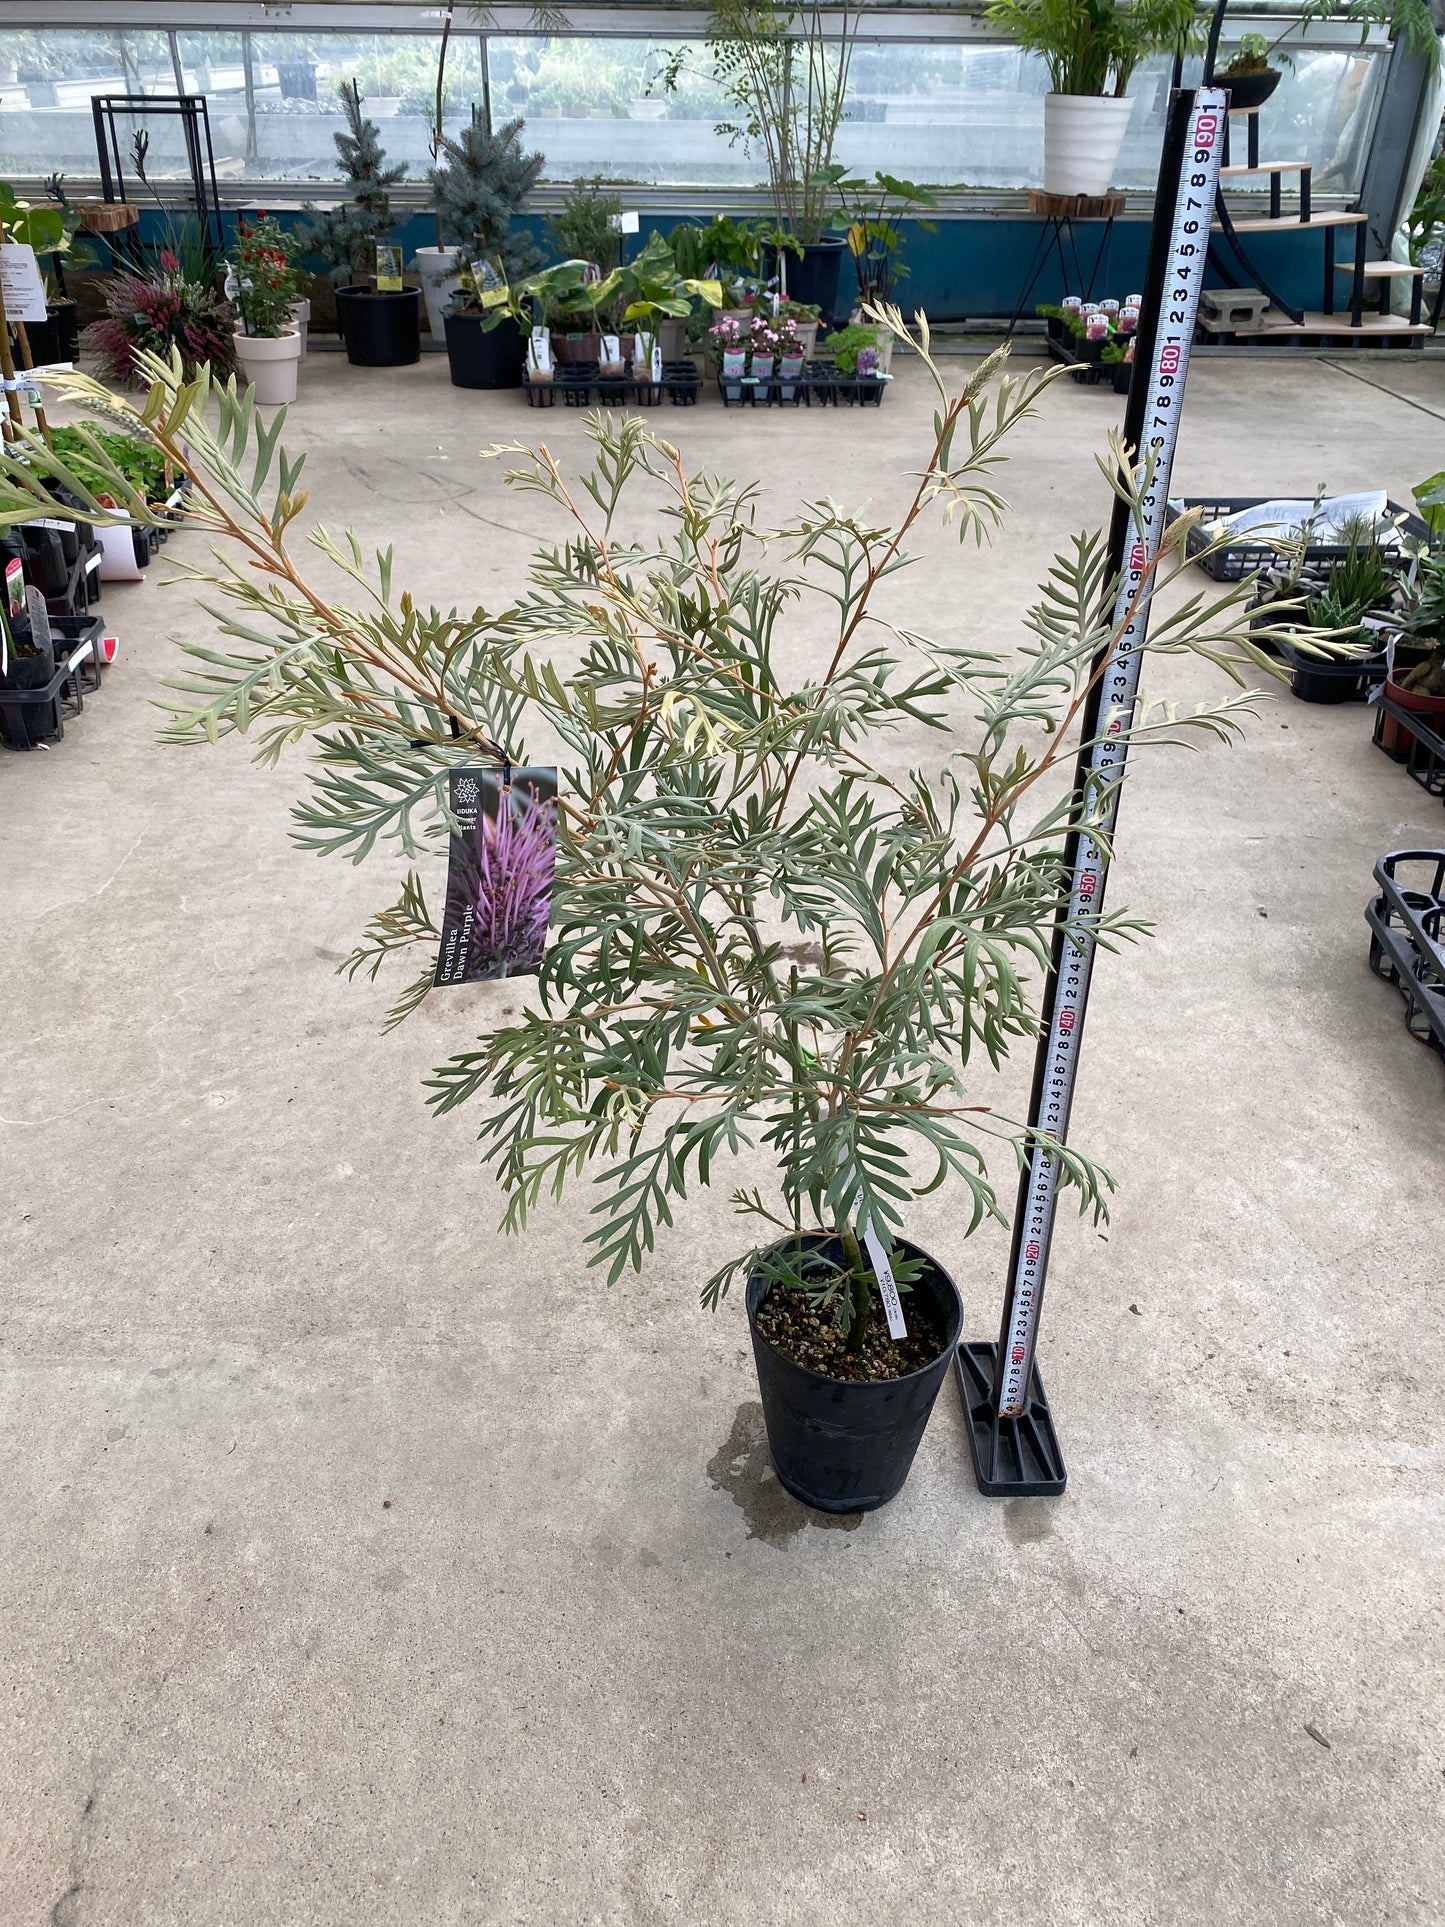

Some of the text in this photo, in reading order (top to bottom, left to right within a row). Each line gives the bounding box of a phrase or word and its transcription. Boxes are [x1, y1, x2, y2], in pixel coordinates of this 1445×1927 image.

[1202, 105, 1217, 113] 1
[1195, 118, 1216, 144] 90
[1194, 149, 1210, 163] 9
[1191, 173, 1206, 187] 8
[1187, 197, 1202, 210] 7
[1184, 220, 1199, 234] 6
[1180, 244, 1195, 257] 5
[1177, 266, 1192, 280] 4
[1173, 289, 1188, 302] 3
[1169, 311, 1185, 323] 2
[1167, 336, 1180, 344] 1
[1161, 348, 1179, 370] 80
[1159, 375, 1174, 387] 9
[1157, 396, 1171, 408] 8
[1153, 416, 1167, 428] 7
[1143, 495, 1155, 507] 3
[1130, 570, 1142, 581] 9
[1119, 642, 1132, 652] 5
[1117, 660, 1129, 669] 4
[1114, 676, 1126, 686] 3
[1110, 693, 1124, 703] 2
[1103, 743, 1116, 752] 9
[1086, 850, 1099, 859] 2
[1081, 875, 1095, 892] 50
[1080, 894, 1091, 902] 9
[453, 904, 475, 979] Dawn Purple
[441, 928, 458, 981] Grevillea
[1071, 950, 1083, 958] 5
[1070, 963, 1081, 971] 4
[1067, 976, 1079, 985] 3
[1065, 990, 1077, 998] 2
[1061, 1011, 1074, 1027] 40
[1060, 1028, 1071, 1037] 9
[1058, 1041, 1069, 1049] 8
[1056, 1053, 1067, 1061] 7
[1054, 1066, 1065, 1074] 6
[1051, 1090, 1062, 1098] 4
[1049, 1102, 1060, 1111] 3
[1047, 1114, 1058, 1123] 2
[1037, 1183, 1047, 1191] 6
[1032, 1216, 1042, 1224] 3
[1031, 1227, 1041, 1235] 2
[1027, 1245, 1038, 1259] 20
[1013, 1346, 1024, 1359] 10
